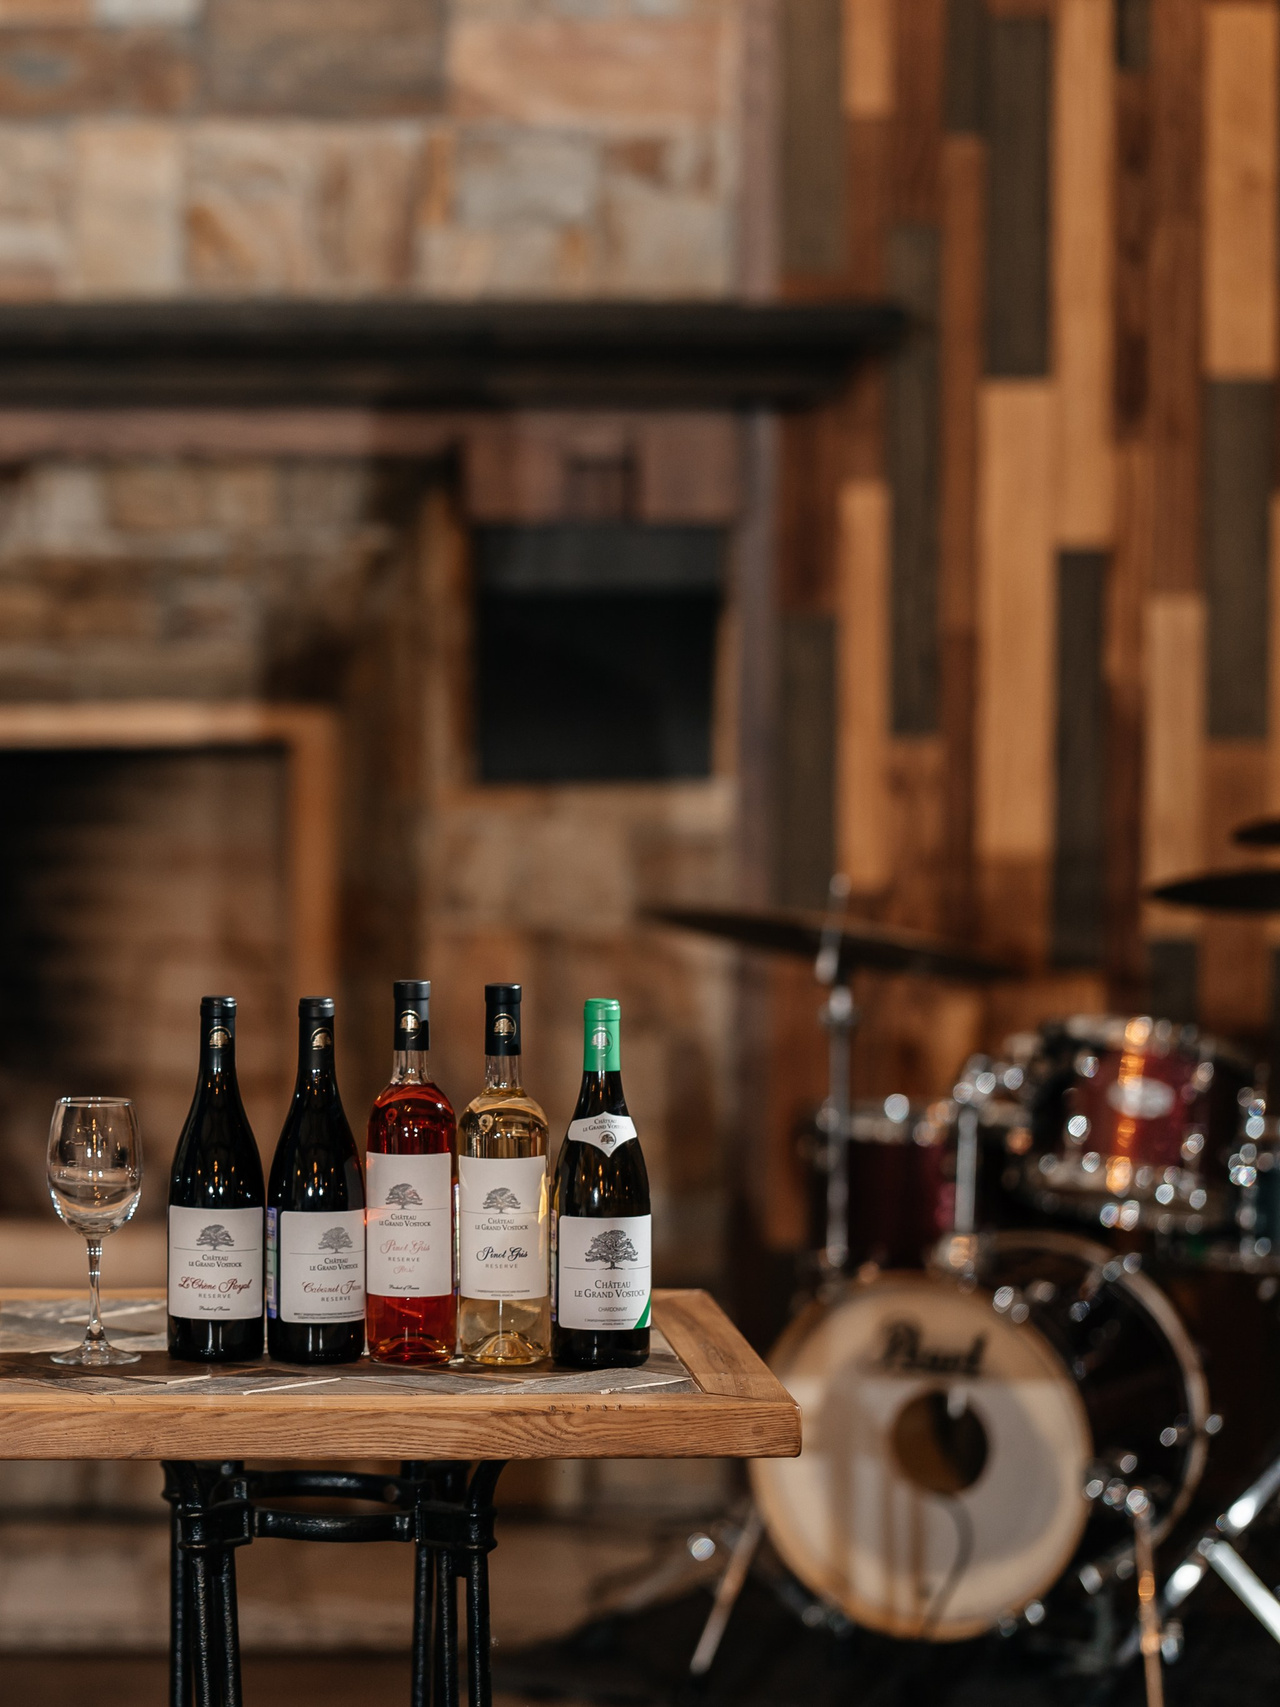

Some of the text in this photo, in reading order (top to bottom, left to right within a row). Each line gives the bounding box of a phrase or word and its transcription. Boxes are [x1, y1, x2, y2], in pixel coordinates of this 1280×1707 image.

[488, 1217, 514, 1225] CHÂTEAU
[476, 1246, 528, 1261] Pinot Gris
[195, 1260, 216, 1268] GRAND
[218, 1278, 252, 1294] Royal
[594, 1279, 631, 1289] CHÂTEAU
[574, 1288, 645, 1298] LE GRAND VOSTOCK
